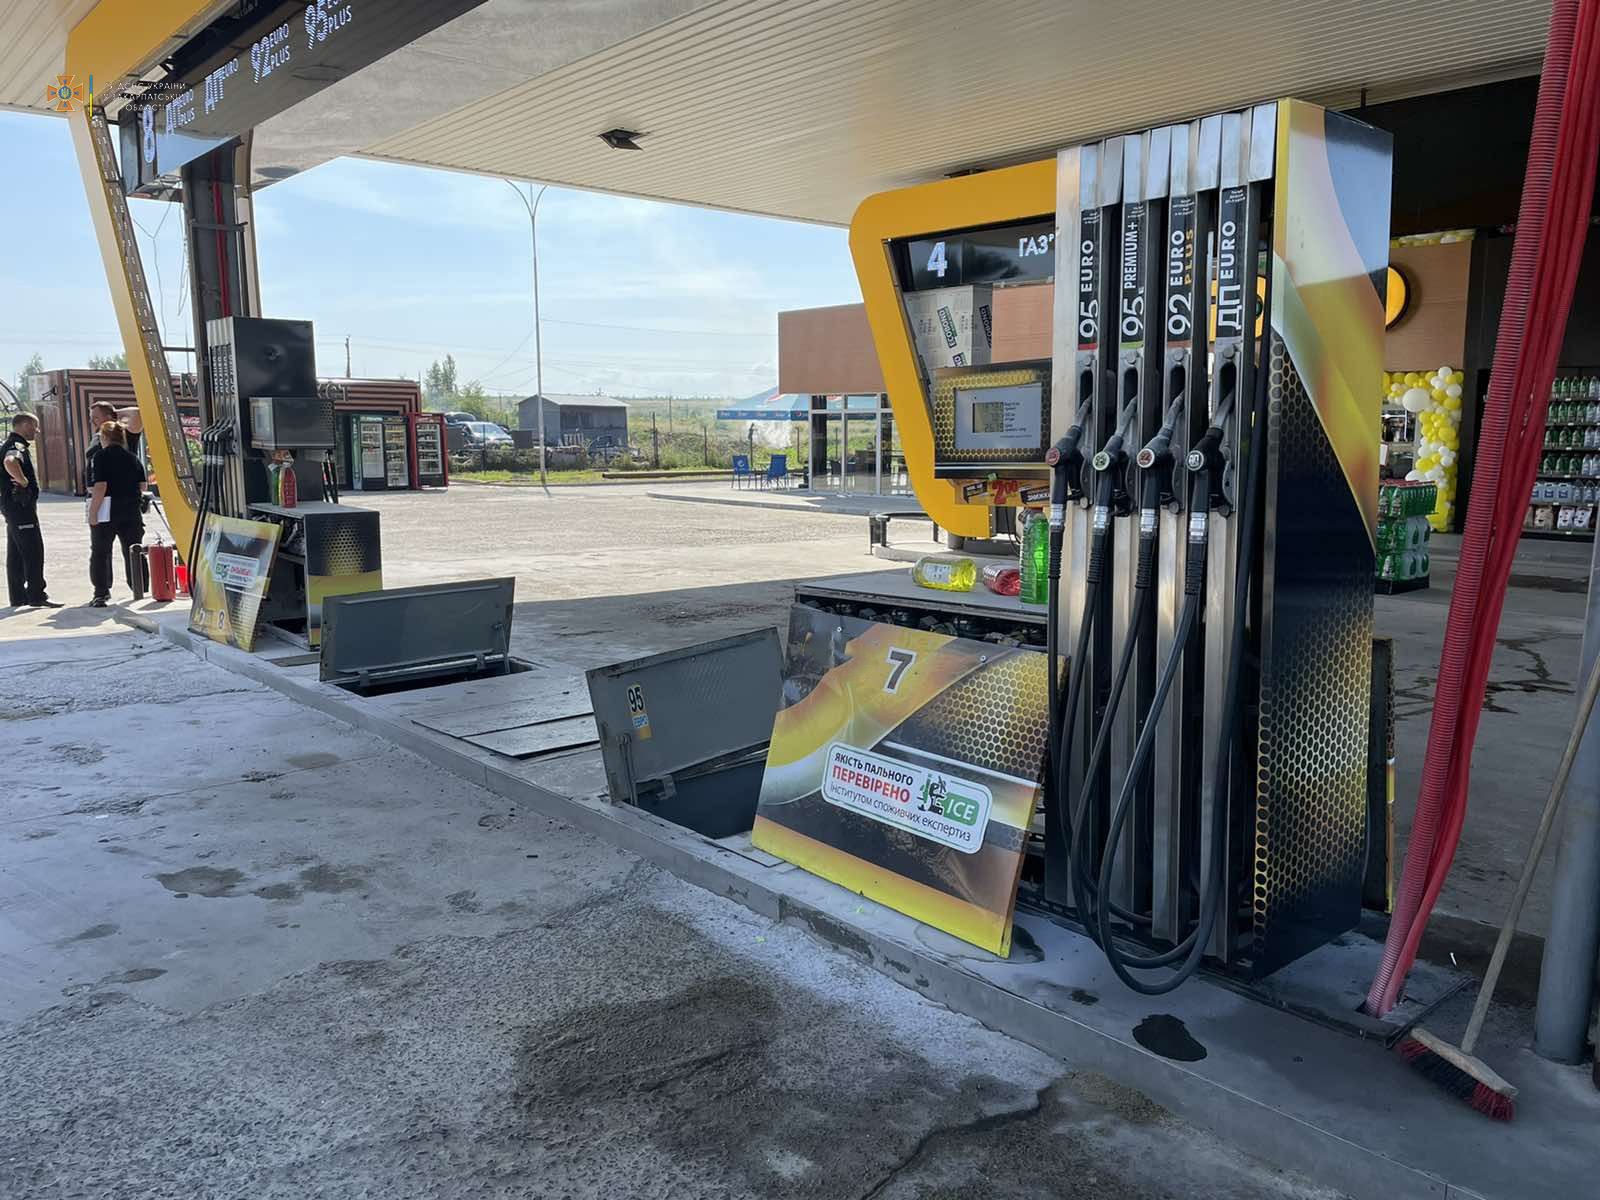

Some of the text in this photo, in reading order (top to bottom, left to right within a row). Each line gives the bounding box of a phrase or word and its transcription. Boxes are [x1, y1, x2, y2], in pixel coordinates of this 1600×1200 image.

[328, 5, 352, 34] PLUS
[250, 23, 290, 83] 92 EURO
[270, 45, 291, 71] PLUS
[927, 241, 948, 278] 4
[1080, 238, 1094, 292] EURO
[1124, 221, 1138, 289] PREMIUM+
[1170, 230, 1185, 287] EURO
[1184, 228, 1194, 285] PLUS
[1220, 220, 1236, 279] EURO
[1080, 299, 1099, 338] 95
[1122, 294, 1144, 337] 95
[1168, 292, 1191, 335] 92
[1218, 285, 1242, 330] ДП
[884, 646, 915, 693] 7
[628, 686, 644, 713] 95
[832, 765, 911, 804] ПЕРЕВІРЕНО
[834, 752, 914, 786] ЯКІСТЬ ПАЛЬНОГО
[873, 798, 921, 824] споживчих
[922, 816, 972, 842] експертиз
[946, 801, 975, 821] ICE
